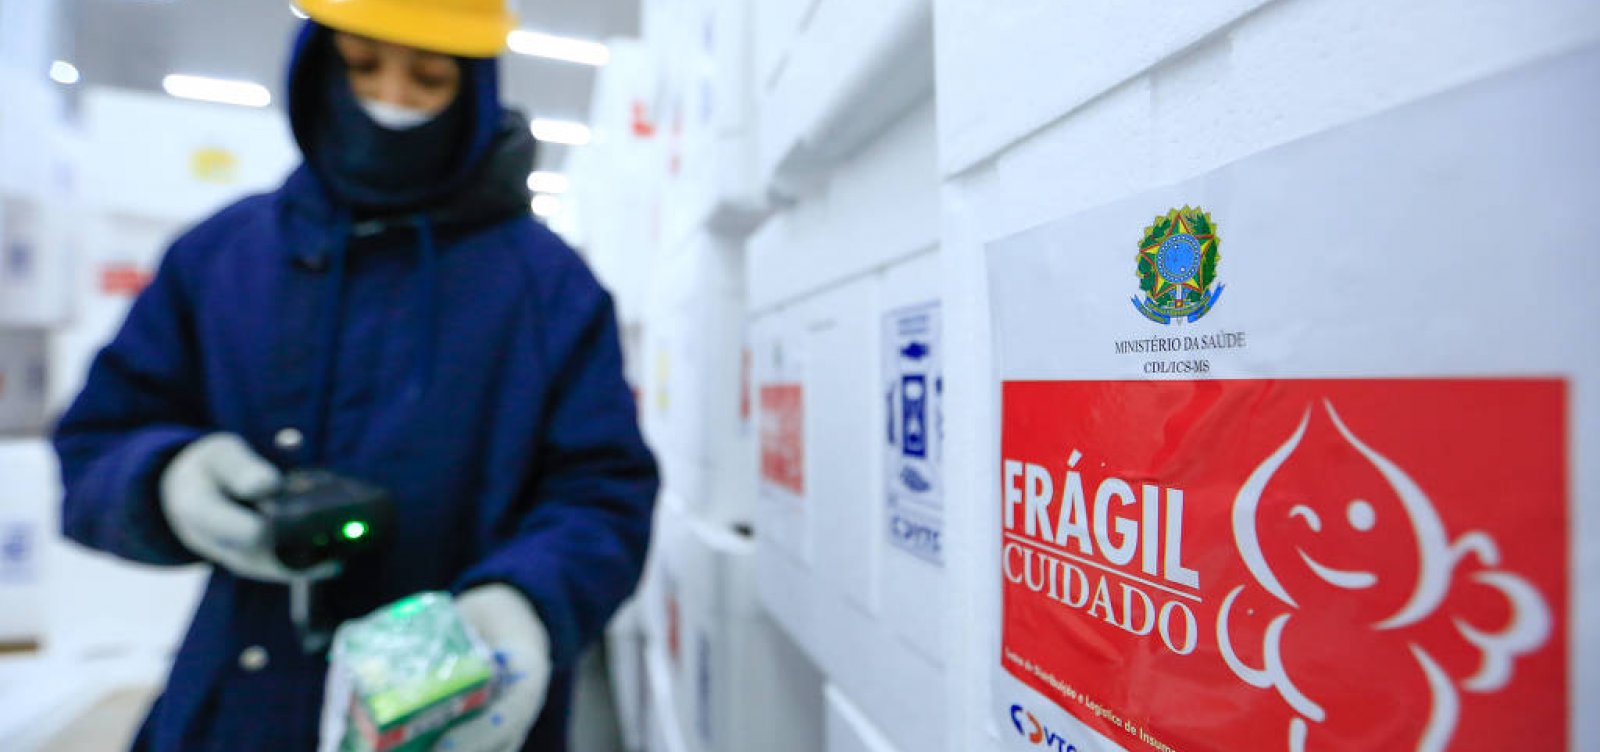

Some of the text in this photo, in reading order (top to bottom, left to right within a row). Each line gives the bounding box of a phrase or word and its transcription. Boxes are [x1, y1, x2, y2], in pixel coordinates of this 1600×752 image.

[1115, 330, 1247, 354] MINISTÉRIO DA SAÚDE
[1143, 360, 1210, 373] CDL/ICS-MS
[1004, 448, 1199, 589] FRÁGIL
[1004, 543, 1198, 656] CUIDADO
[1125, 719, 1136, 735] de
